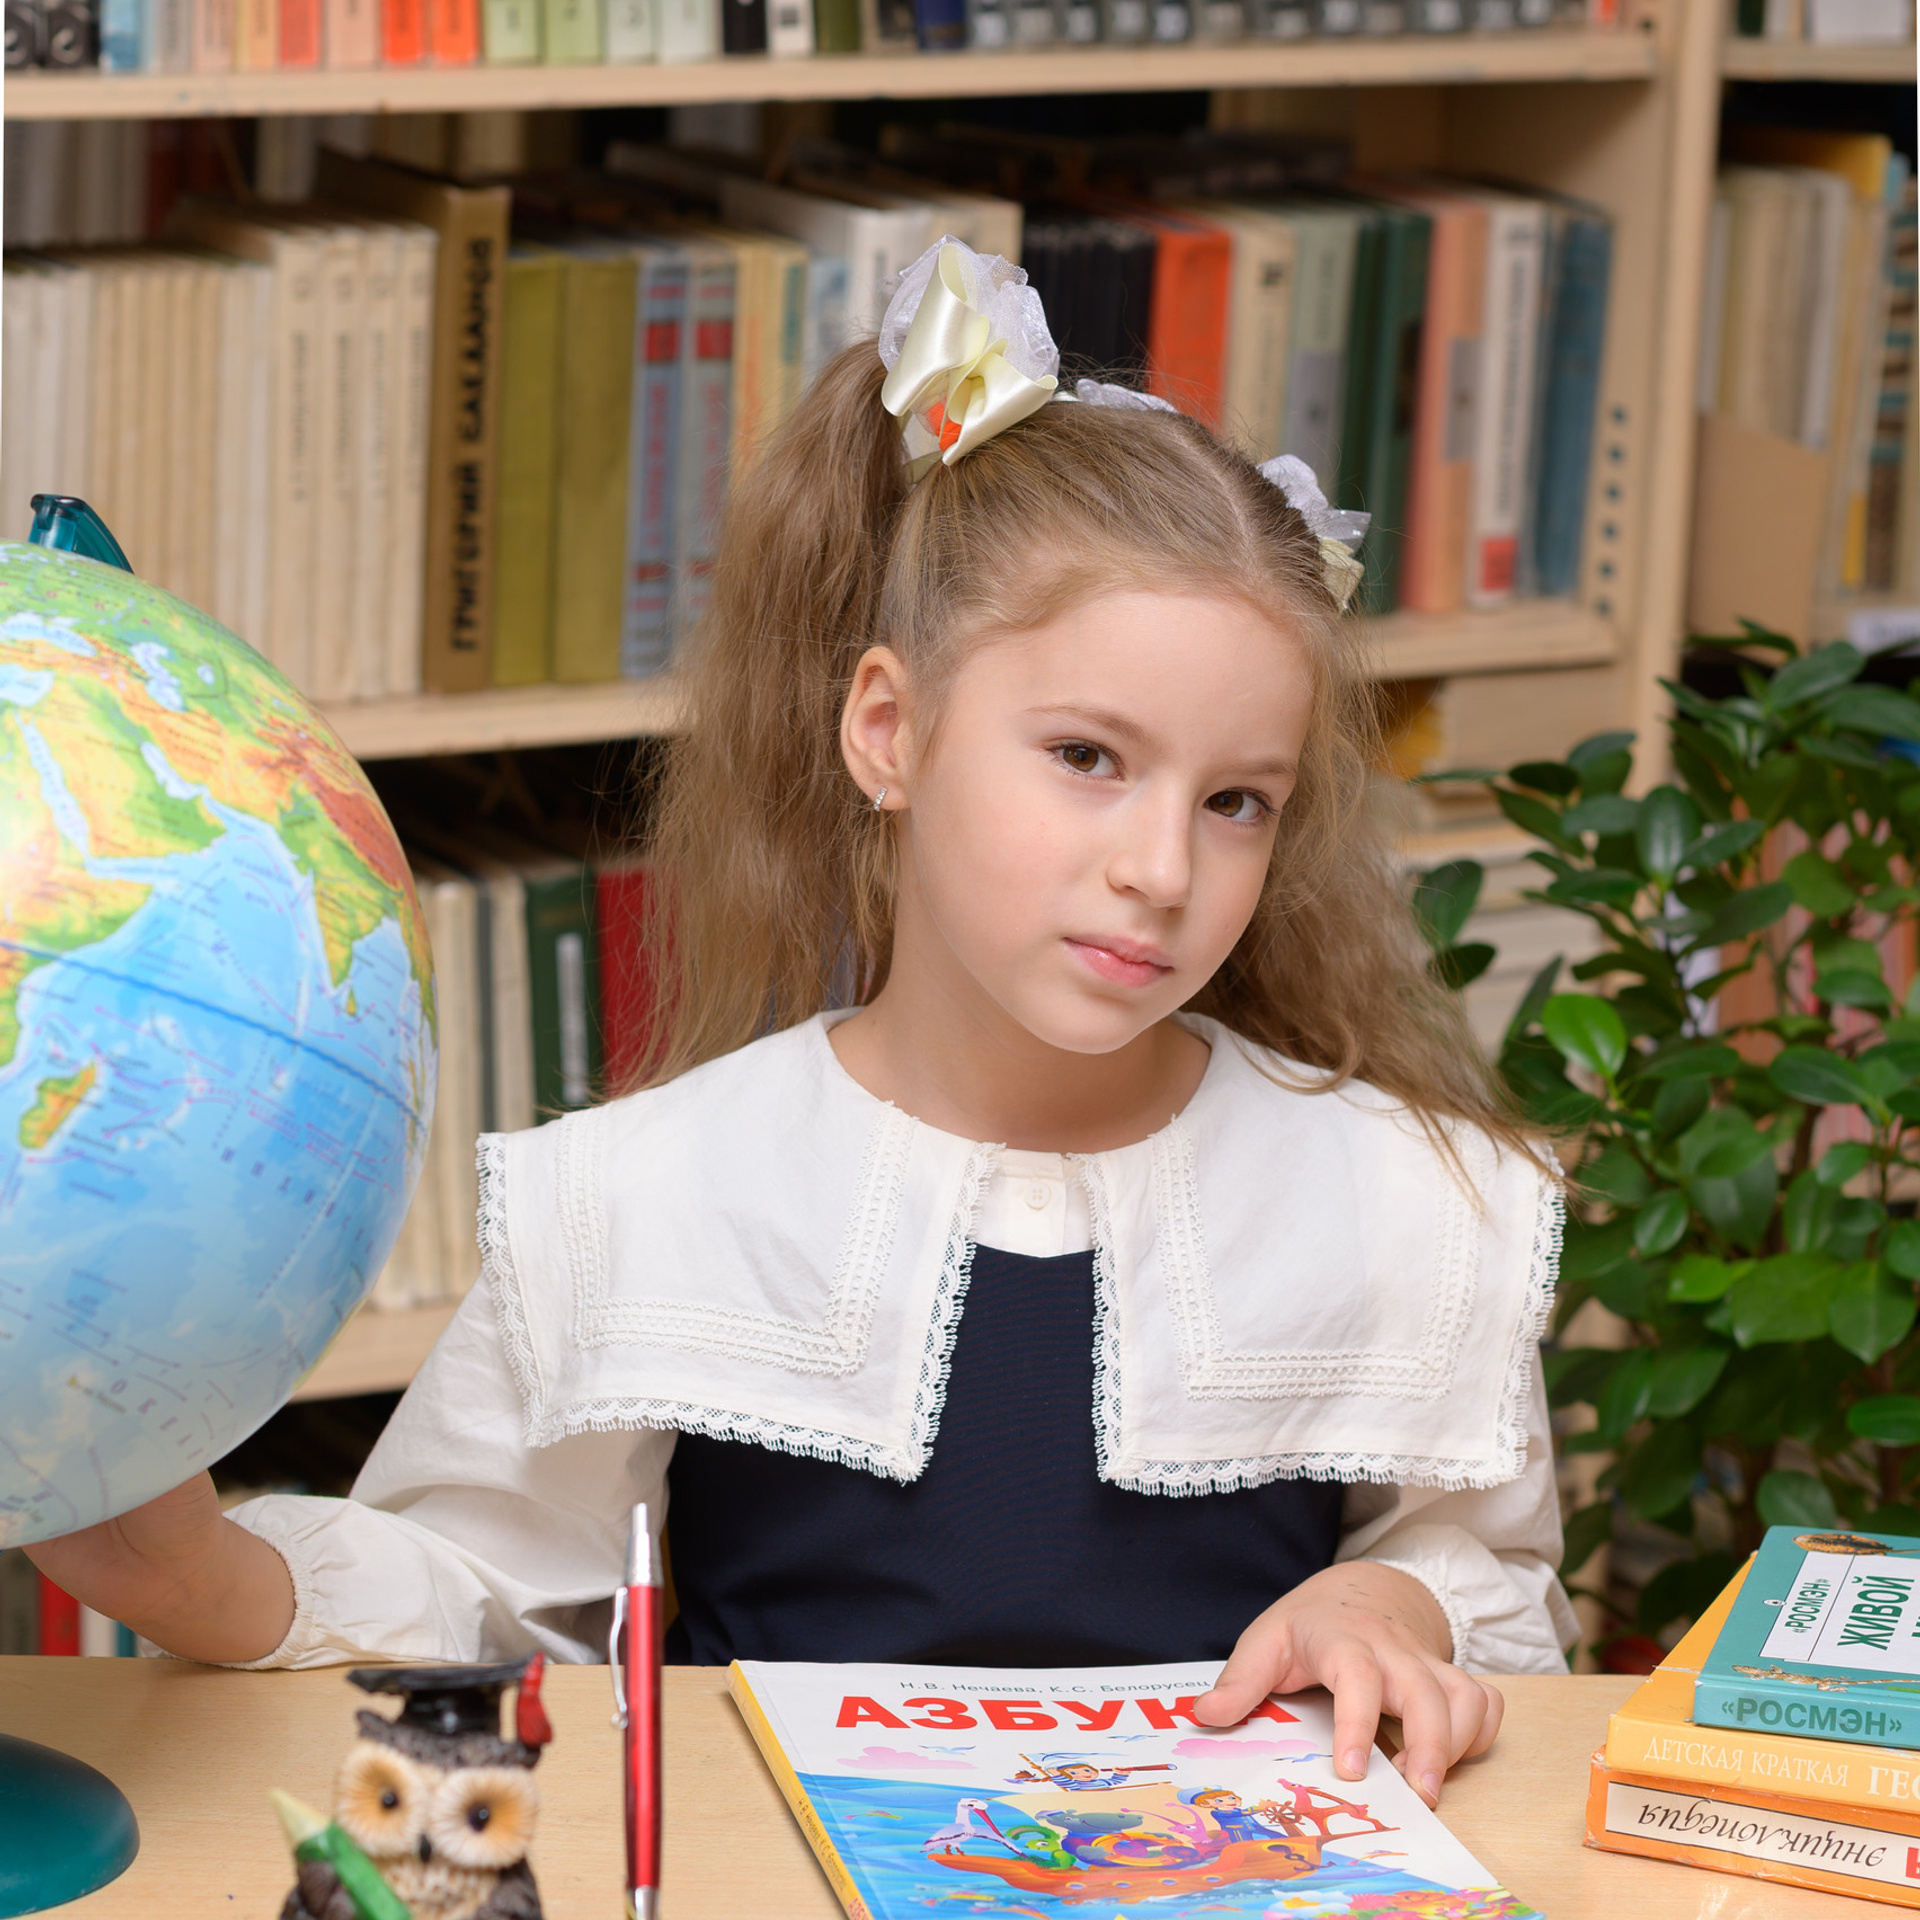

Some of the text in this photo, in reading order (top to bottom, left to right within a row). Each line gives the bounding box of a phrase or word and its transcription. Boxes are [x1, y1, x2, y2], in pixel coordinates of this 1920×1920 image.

[1785, 1578, 1831, 1633] «РОСМЭН»
[1837, 1575, 1915, 1651] ЖИВОЙ
[953, 1683, 1043, 1694] Нечаева,
[1100, 1680, 1211, 1693] Белорусец
[1721, 1697, 1902, 1737] «РОСМЭН»
[1643, 1737, 1920, 1800] ДЕТСКАЯ КРАТКАЯ ГЕ
[1638, 1798, 1887, 1868] энциклопедия
